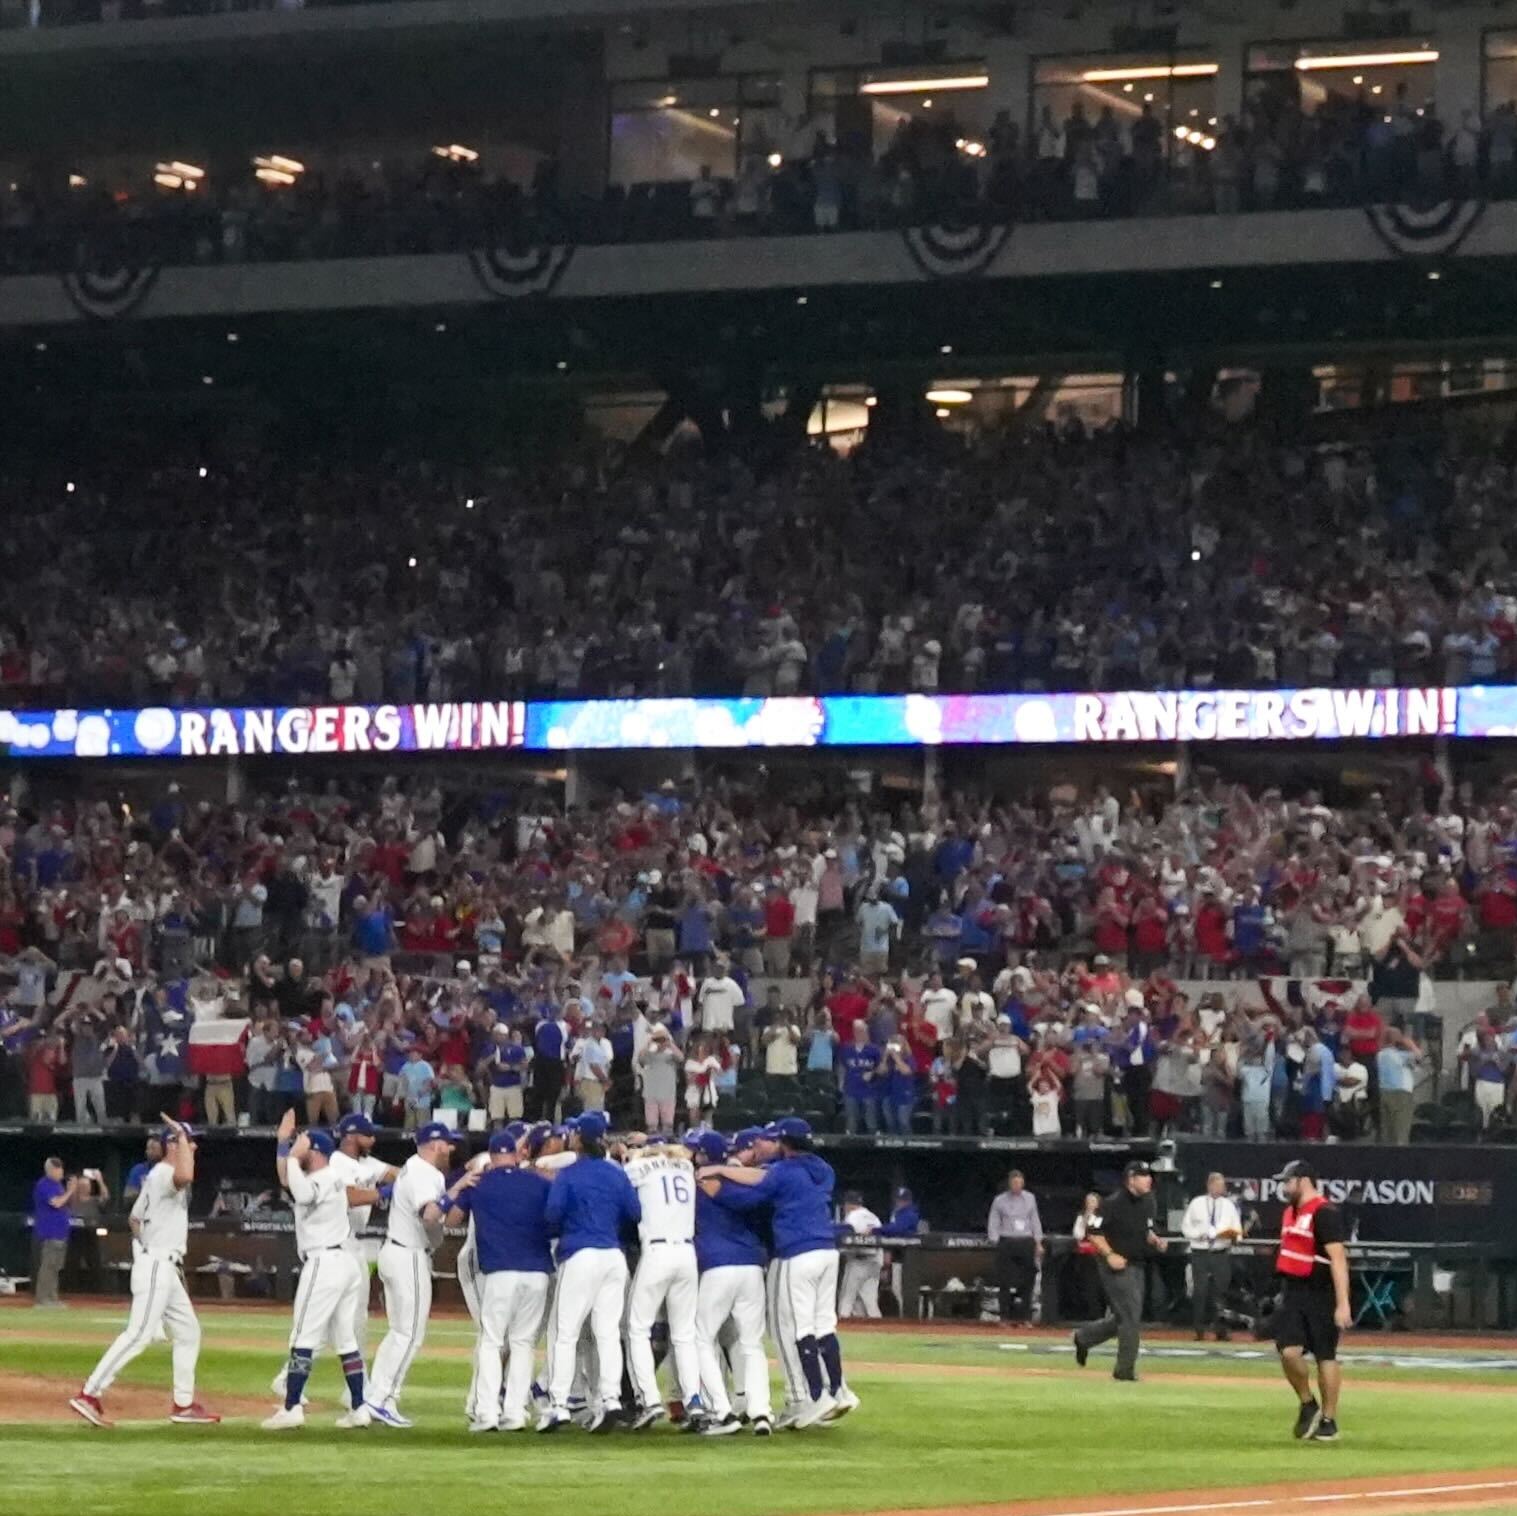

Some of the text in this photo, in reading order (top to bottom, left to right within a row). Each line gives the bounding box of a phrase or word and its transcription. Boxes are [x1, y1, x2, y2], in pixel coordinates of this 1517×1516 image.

[179, 701, 526, 756] RANGERS WIN!
[1074, 686, 1458, 741] RANGERS WIN!
[661, 1175, 689, 1205] 16
